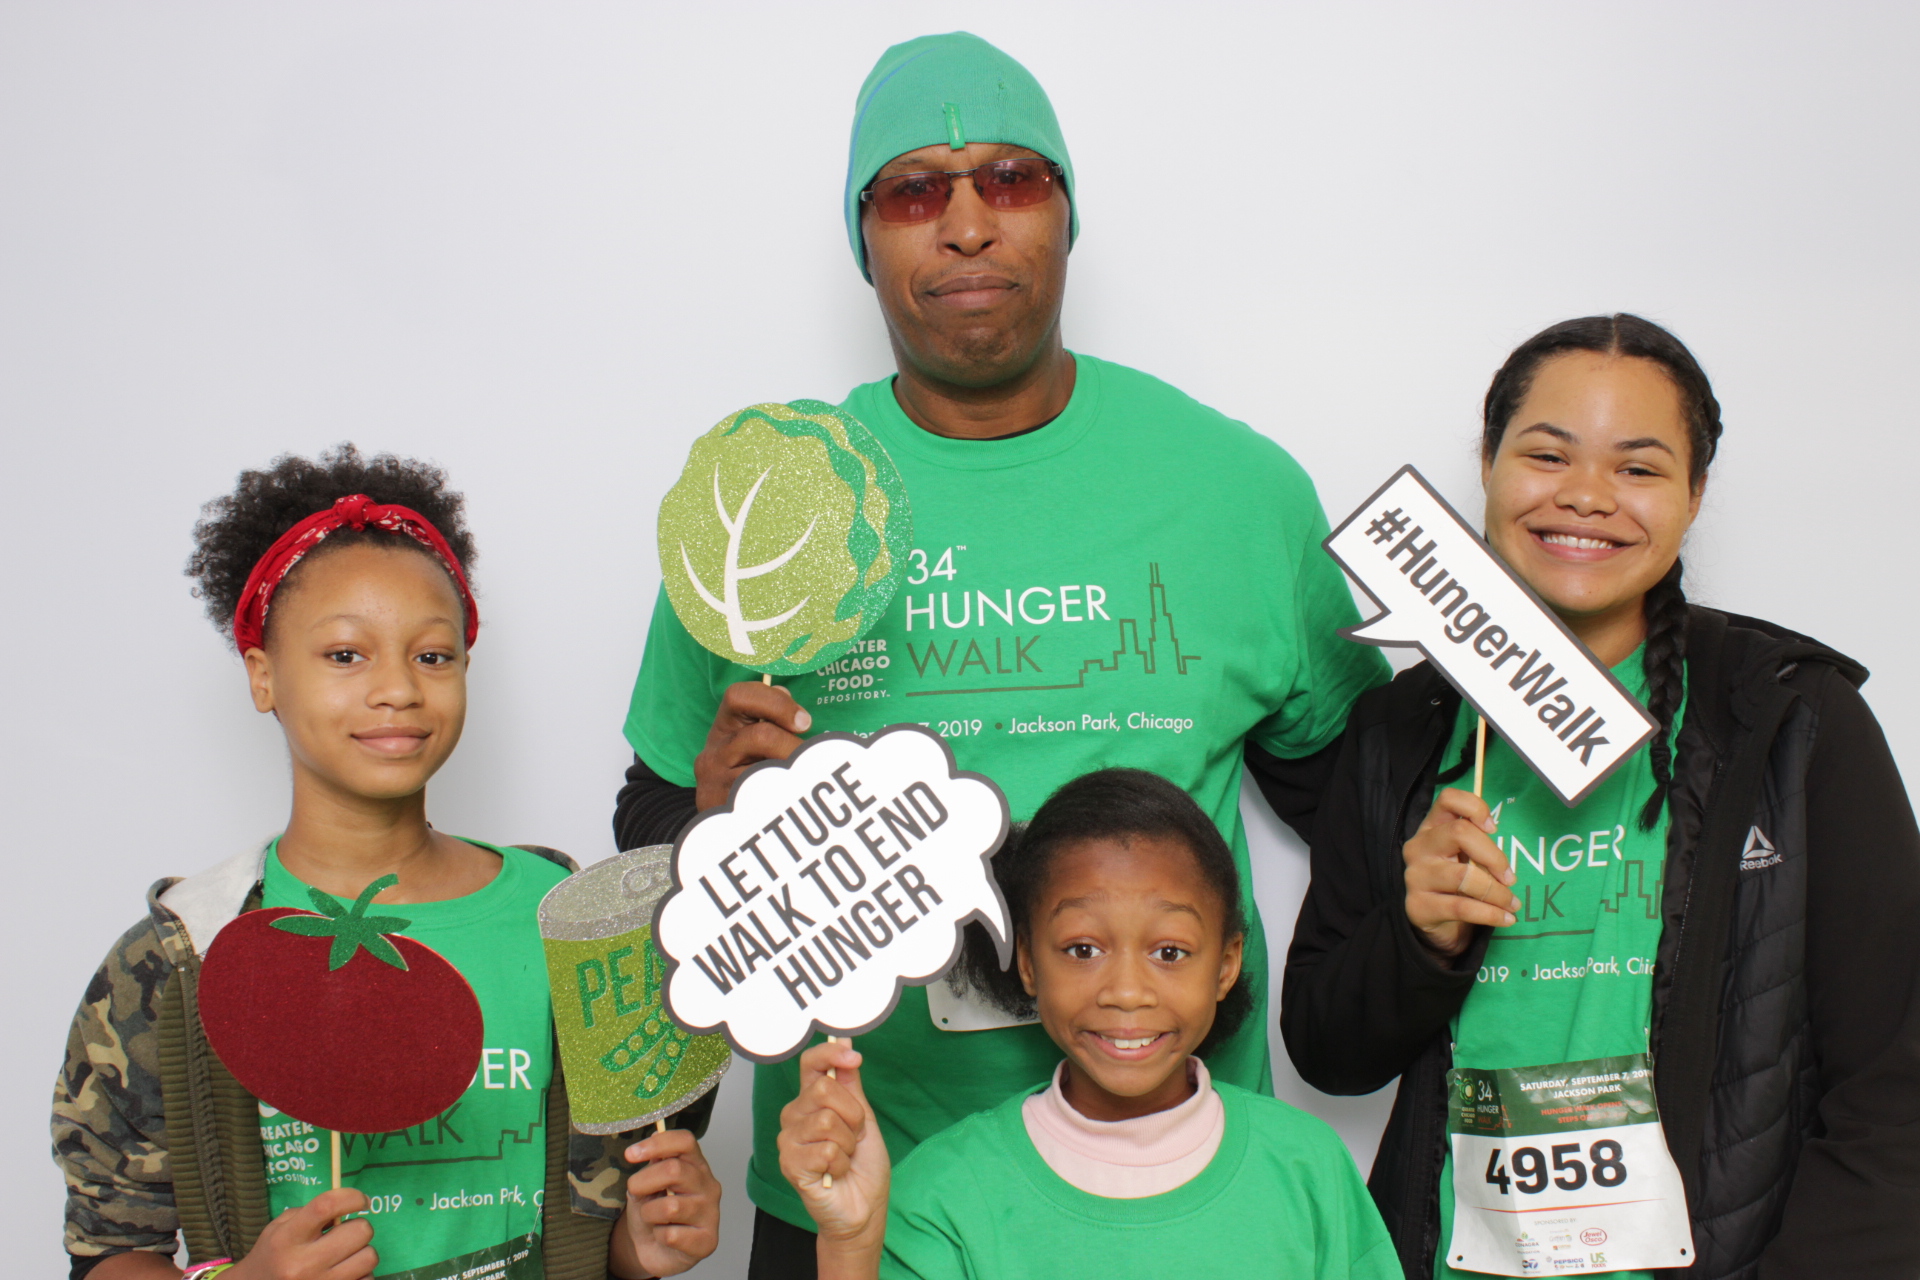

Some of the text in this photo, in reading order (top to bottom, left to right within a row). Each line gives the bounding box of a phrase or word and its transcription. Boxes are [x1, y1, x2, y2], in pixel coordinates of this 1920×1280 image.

[906, 584, 1111, 632] HUNGER
[846, 639, 887, 655] ATER
[1364, 507, 1610, 767] #HungerWalk
[816, 655, 890, 677] CHICAGO
[906, 635, 1043, 678] WALK
[939, 712, 1193, 738] 2019 Jackson Park, Chicago
[698, 761, 877, 919] LETTUCE
[1497, 824, 1625, 876] NGER
[1739, 854, 1783, 871] Reebok
[692, 781, 949, 996] WALK TO END
[1514, 881, 1567, 923] LK
[773, 864, 943, 1011] HUNGER
[575, 938, 668, 1029] PEA
[1476, 966, 1510, 983] 019
[1532, 960, 1586, 981] Jackso
[1626, 957, 1656, 976] Chic
[1520, 1079, 1569, 1091] SATURDAY,
[1571, 1073, 1620, 1086] SEPTEMBER
[1632, 1069, 1648, 1079] 201
[1553, 1084, 1622, 1099] JACKSON PARK
[260, 1121, 315, 1140] REATER
[1485, 1138, 1628, 1195] 4958
[358, 1193, 403, 1215] 019
[462, 1259, 506, 1279] SEPTEMBER
[512, 1249, 529, 1263] 2019
